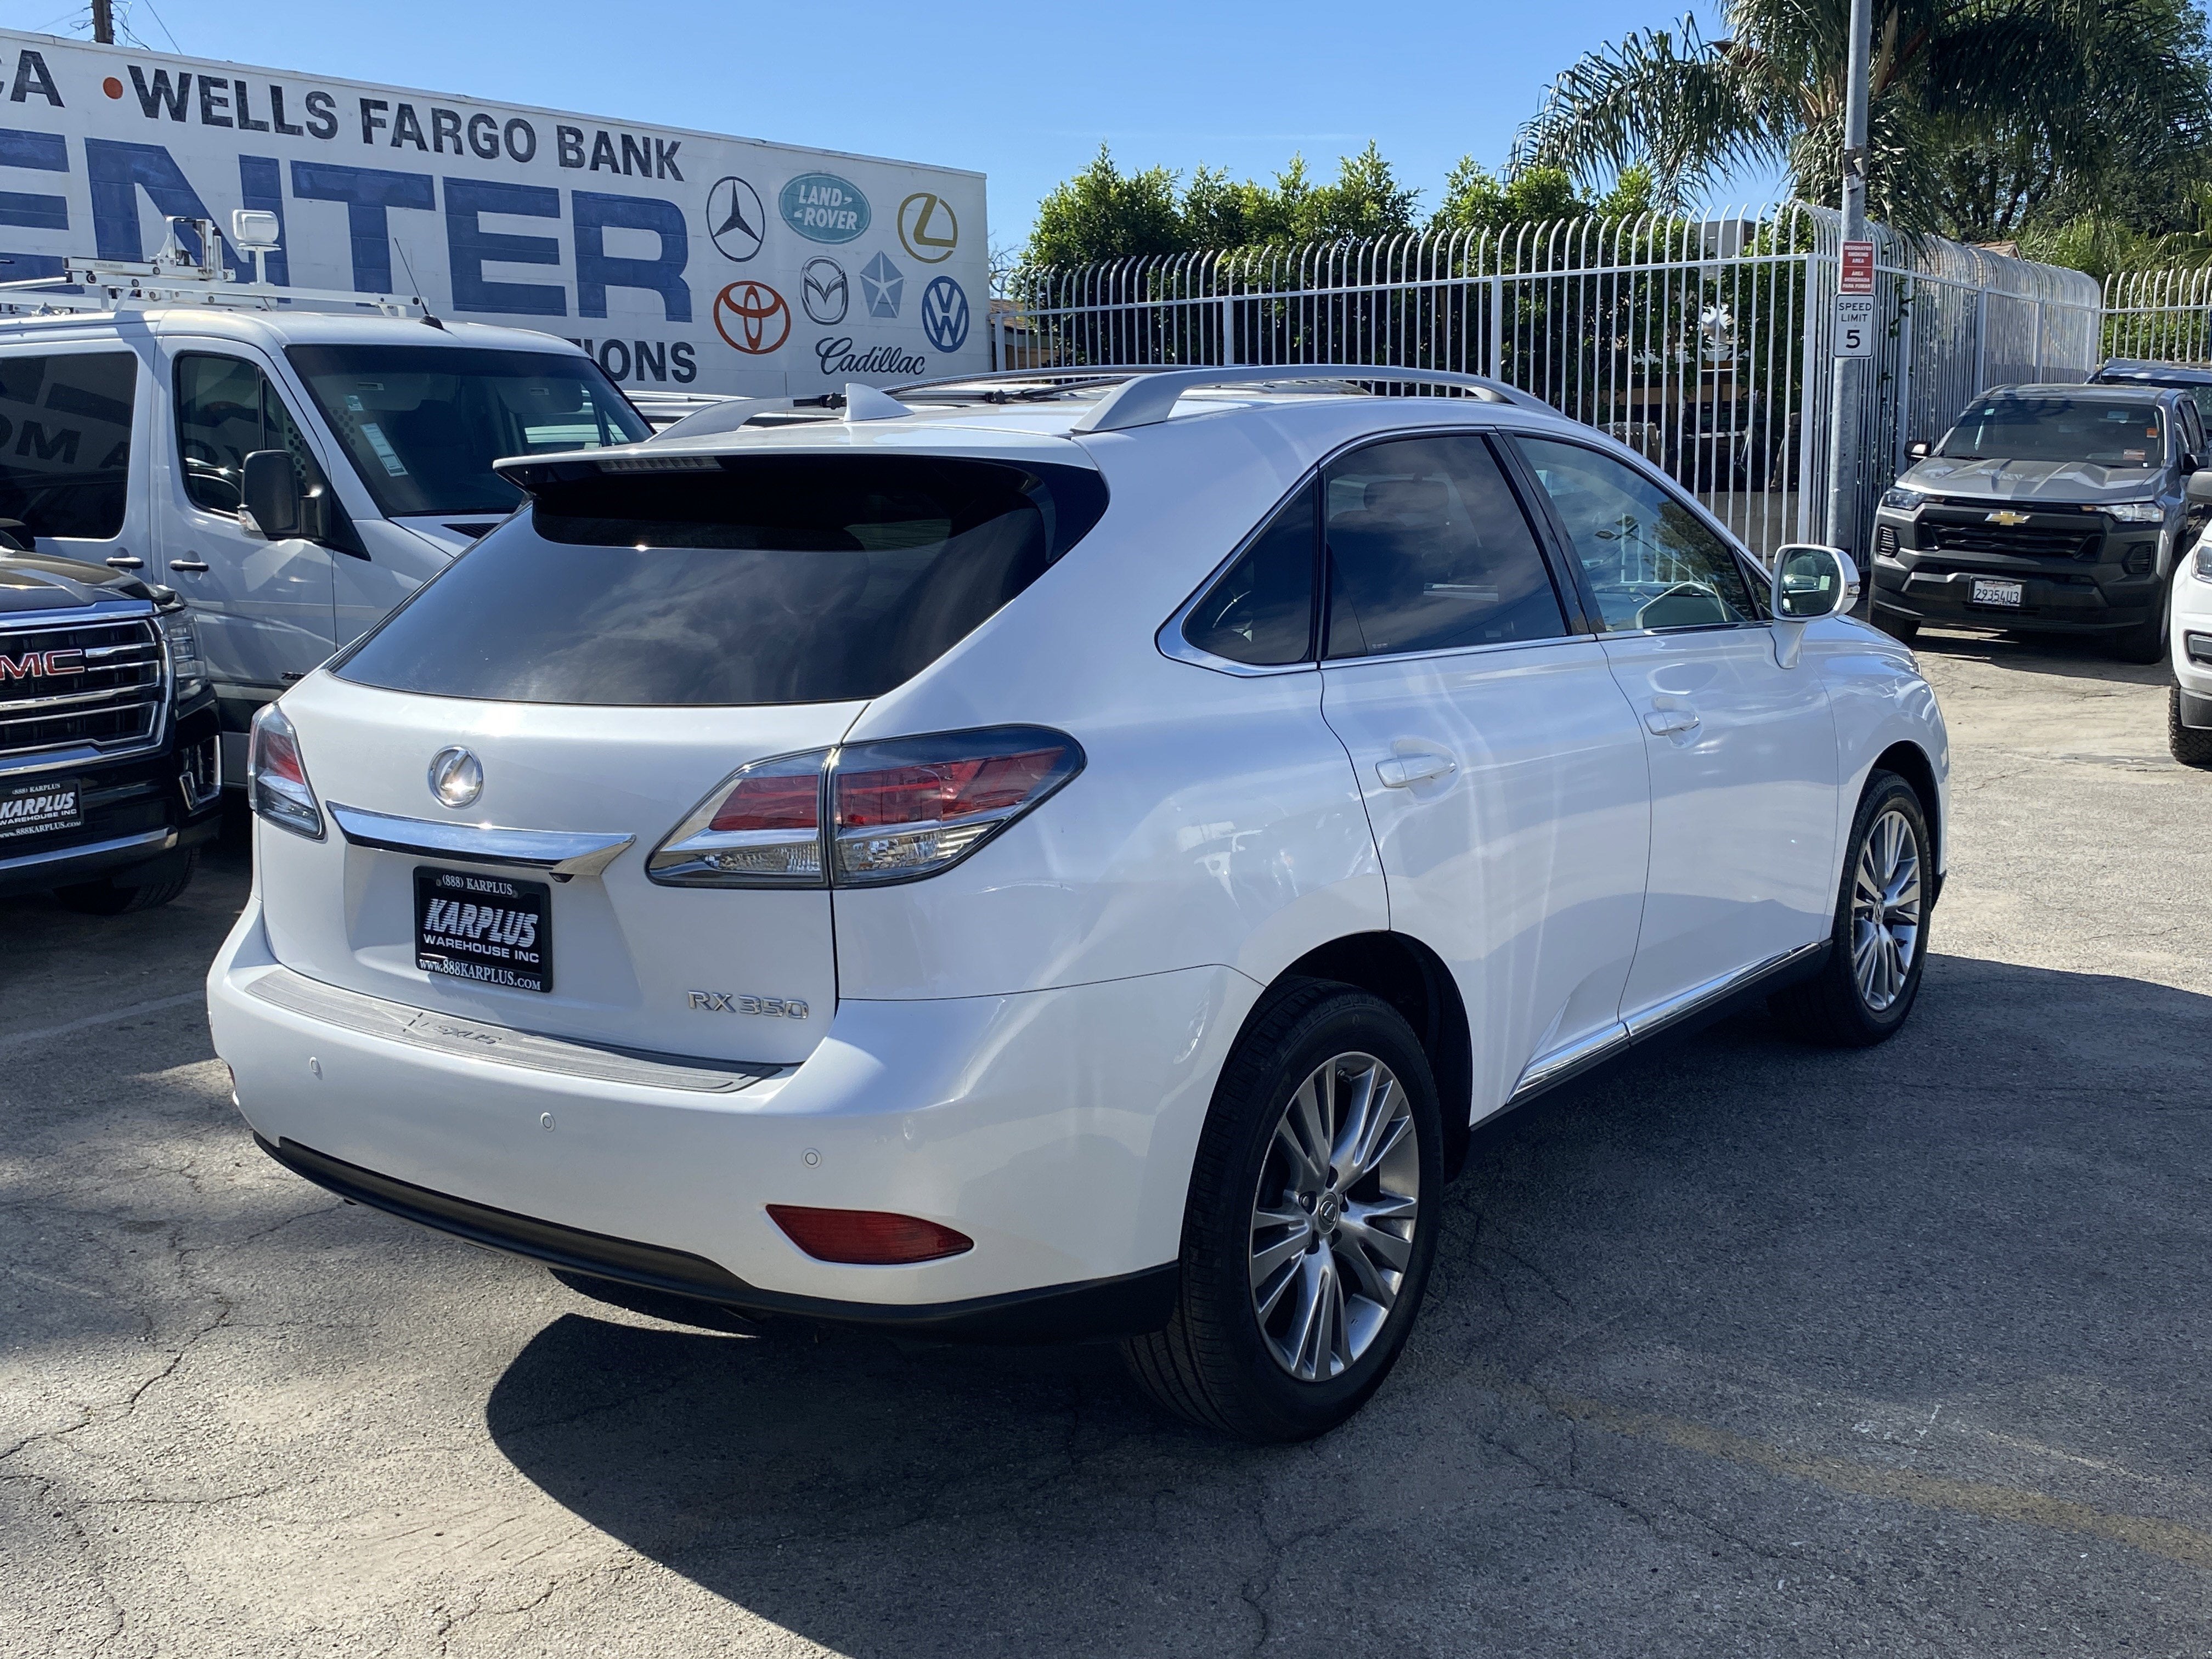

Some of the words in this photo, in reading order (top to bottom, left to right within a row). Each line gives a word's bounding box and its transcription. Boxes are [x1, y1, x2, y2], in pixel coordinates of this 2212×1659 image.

[0, 49, 65, 108] A
[127, 64, 337, 139] WELLS
[359, 98, 536, 163] FARGO
[556, 124, 685, 182] BANK
[799, 185, 845, 207] LAND
[803, 208, 857, 230] ROVER
[1838, 303, 1872, 311] SPEED
[1841, 314, 1867, 322] LIMIT
[1846, 329, 1860, 348] 5
[564, 338, 697, 383] ONS
[815, 336, 926, 375] Cadillac
[30, 783, 61, 793] KARPLUS
[0, 792, 75, 819] KARPLUS
[0, 811, 59, 826] WAREHOUSE
[442, 874, 464, 888] (888)
[466, 878, 512, 895] KARPLUS
[424, 898, 539, 947] KARPLUS
[423, 934, 510, 958] WAREHOUSE
[515, 950, 539, 963] INC
[688, 990, 736, 1013] RX
[739, 995, 809, 1019] 350
